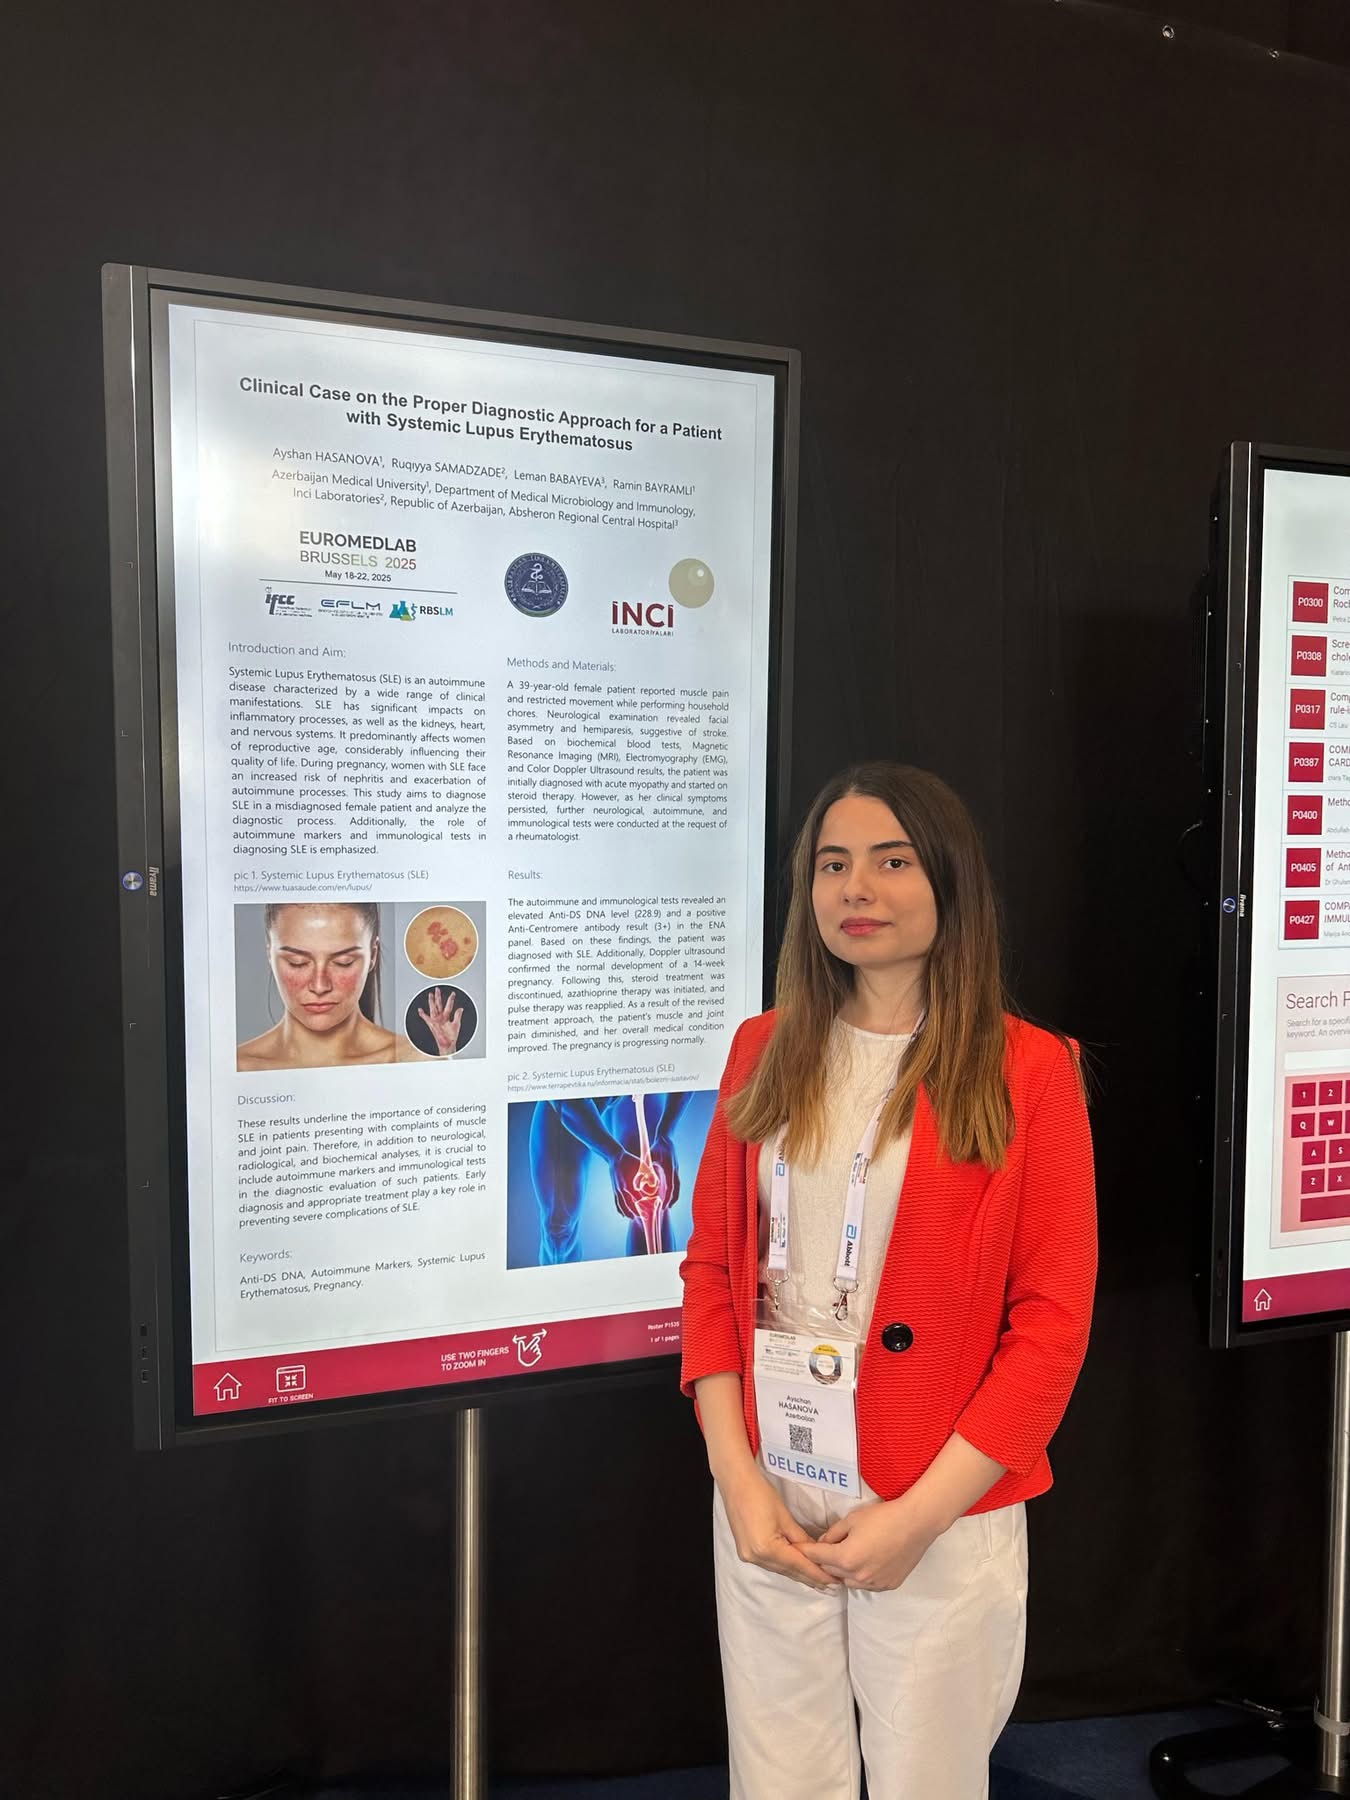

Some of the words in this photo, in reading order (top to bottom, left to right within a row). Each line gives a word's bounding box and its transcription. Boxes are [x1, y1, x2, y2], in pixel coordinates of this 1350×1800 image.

[239, 377, 303, 396] Clinical
[309, 384, 351, 401] Case
[356, 392, 376, 404] on
[381, 391, 407, 407] the
[413, 394, 467, 415] Proper
[472, 400, 554, 422] Diagnostic
[558, 410, 631, 431] Approach
[634, 418, 656, 433] for
[659, 424, 668, 434] a
[672, 422, 722, 440] Patient
[346, 410, 380, 425] with
[386, 413, 460, 433] Systemic
[465, 420, 514, 440] Lupus
[519, 426, 632, 451] Erythematosus
[272, 447, 312, 460] Ayshan
[514, 469, 546, 482] Leman
[613, 478, 642, 491] Ramin
[271, 469, 328, 485] Azerbaijan
[332, 473, 373, 487] Medical
[434, 482, 495, 498] Department
[497, 488, 508, 499] of
[510, 489, 548, 503] Medical
[551, 493, 613, 511] Microbiology
[615, 500, 633, 510] and
[293, 487, 311, 498] Inci
[390, 495, 434, 509] Republic
[437, 499, 448, 510] of
[508, 506, 555, 519] Absheron
[558, 510, 599, 524] Regional
[601, 514, 635, 526] Central
[300, 530, 416, 552] EUROMEDLAB
[300, 550, 377, 567] BRUSSELS
[384, 556, 416, 570] 2025
[324, 569, 342, 580] May
[371, 572, 391, 582] 2025
[320, 599, 381, 611] EFLM
[1297, 597, 1324, 608] P0300
[419, 605, 454, 617] RBSLM
[228, 641, 295, 655] Introduction
[298, 645, 318, 656] and
[1331, 639, 1350, 648] Scre
[506, 656, 549, 668] Methods
[551, 659, 569, 669] and
[1296, 651, 1322, 661] P0308
[228, 666, 272, 678] Systemic
[274, 668, 304, 680] Lupus
[306, 669, 376, 682] Erythematosus
[379, 673, 401, 685] (SLE)
[404, 676, 411, 684] is
[428, 677, 485, 688] autoimmune
[506, 679, 514, 688] A
[519, 680, 569, 692] 39-year-old
[573, 682, 602, 693] female
[606, 684, 635, 695] patient
[640, 687, 675, 696] reported
[680, 688, 708, 697] muscle
[712, 689, 729, 699] pain
[1295, 704, 1321, 714] P0317
[1329, 745, 1350, 754] COM
[1293, 758, 1320, 767] P0387
[1292, 810, 1318, 820] P0400
[1291, 863, 1316, 872] P0405
[1325, 862, 1335, 871] of
[233, 871, 248, 882] pic
[260, 870, 303, 882] Systemic
[306, 871, 334, 881] Lupus
[337, 869, 404, 881] Erythematosus
[407, 869, 428, 880] (SLE)
[1289, 915, 1315, 925] P0427
[1286, 990, 1338, 1010] Search
[1287, 1018, 1311, 1027] Search
[1311, 1018, 1321, 1026] for
[1299, 1121, 1306, 1130] Q
[844, 1240, 854, 1267] Abbott
[239, 1272, 277, 1285] Anti-DS
[310, 1265, 370, 1277] Autoimmune
[417, 1255, 455, 1268] Systemic
[459, 1252, 485, 1262] Lupus
[441, 1352, 456, 1362] USE
[458, 1350, 476, 1359] TWO
[477, 1346, 510, 1357] FINGERS
[441, 1363, 452, 1371] TO
[453, 1360, 477, 1370] ZOOM
[478, 1359, 487, 1367] IN
[290, 1393, 314, 1401] SCREEN
[778, 1401, 820, 1416] HASANOVA
[767, 1452, 849, 1488] DELEGATE
